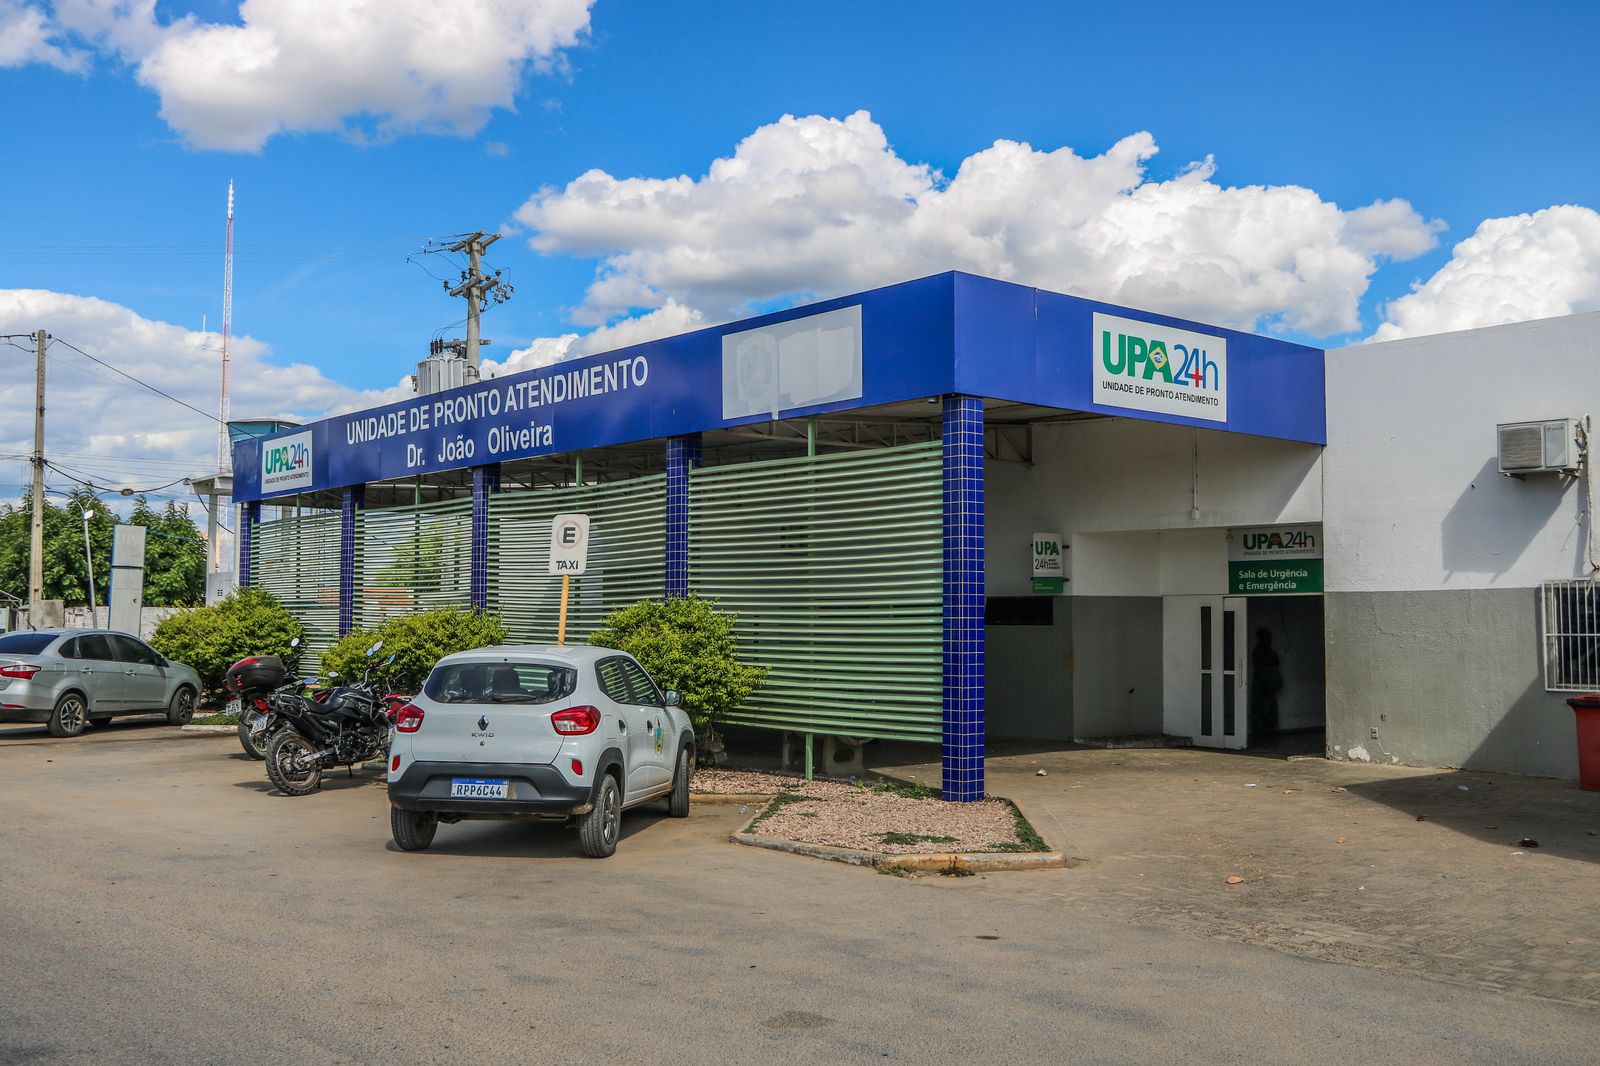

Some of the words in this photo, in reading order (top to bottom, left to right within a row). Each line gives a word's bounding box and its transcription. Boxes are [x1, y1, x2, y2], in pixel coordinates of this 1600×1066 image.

[1103, 330, 1173, 384] UPA
[1174, 344, 1219, 391] 24h
[347, 410, 406, 445] UNIDADE
[410, 405, 430, 432] DE
[434, 388, 500, 427] PRONTO
[504, 355, 649, 413] ATENDIMENTO
[1102, 380, 1133, 394] UNIDADE
[1135, 385, 1145, 395] DE
[1146, 387, 1174, 400] PRONTO
[1175, 391, 1219, 407] ATENDIMENTO
[407, 443, 425, 468] Dr.
[438, 434, 475, 463] João
[488, 421, 553, 454] Oliveira
[563, 526, 576, 543] E
[1035, 541, 1060, 555] UPA
[556, 560, 579, 570] TAXI
[1035, 558, 1048, 570] 24h
[1239, 570, 1256, 579] Sala
[1257, 570, 1268, 578] de
[1270, 569, 1308, 580] Urgência
[1246, 581, 1297, 591] Emergência
[456, 784, 502, 796] RPP6C44
